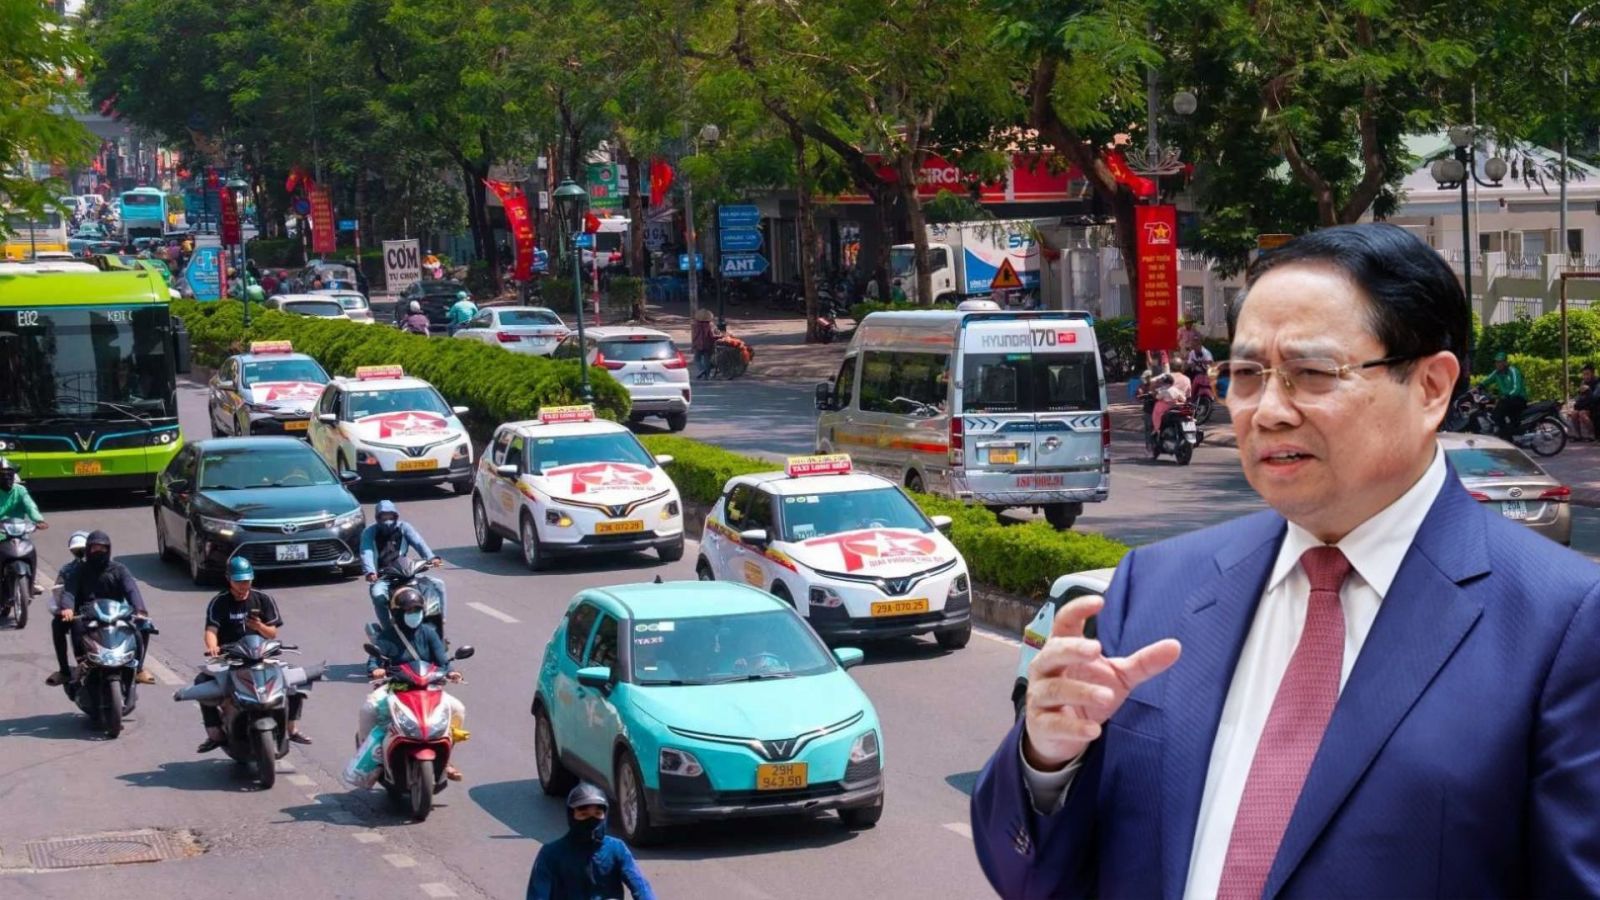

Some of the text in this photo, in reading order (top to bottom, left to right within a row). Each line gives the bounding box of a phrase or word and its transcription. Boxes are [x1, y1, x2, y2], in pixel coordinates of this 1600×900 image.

[387, 242, 418, 269] CƠM
[725, 260, 755, 270] ANT
[17, 311, 38, 326] E02
[982, 335, 1030, 347] HYUNDAI
[1031, 329, 1056, 346] 170
[792, 464, 809, 472] TAXI
[772, 764, 793, 775] 29H
